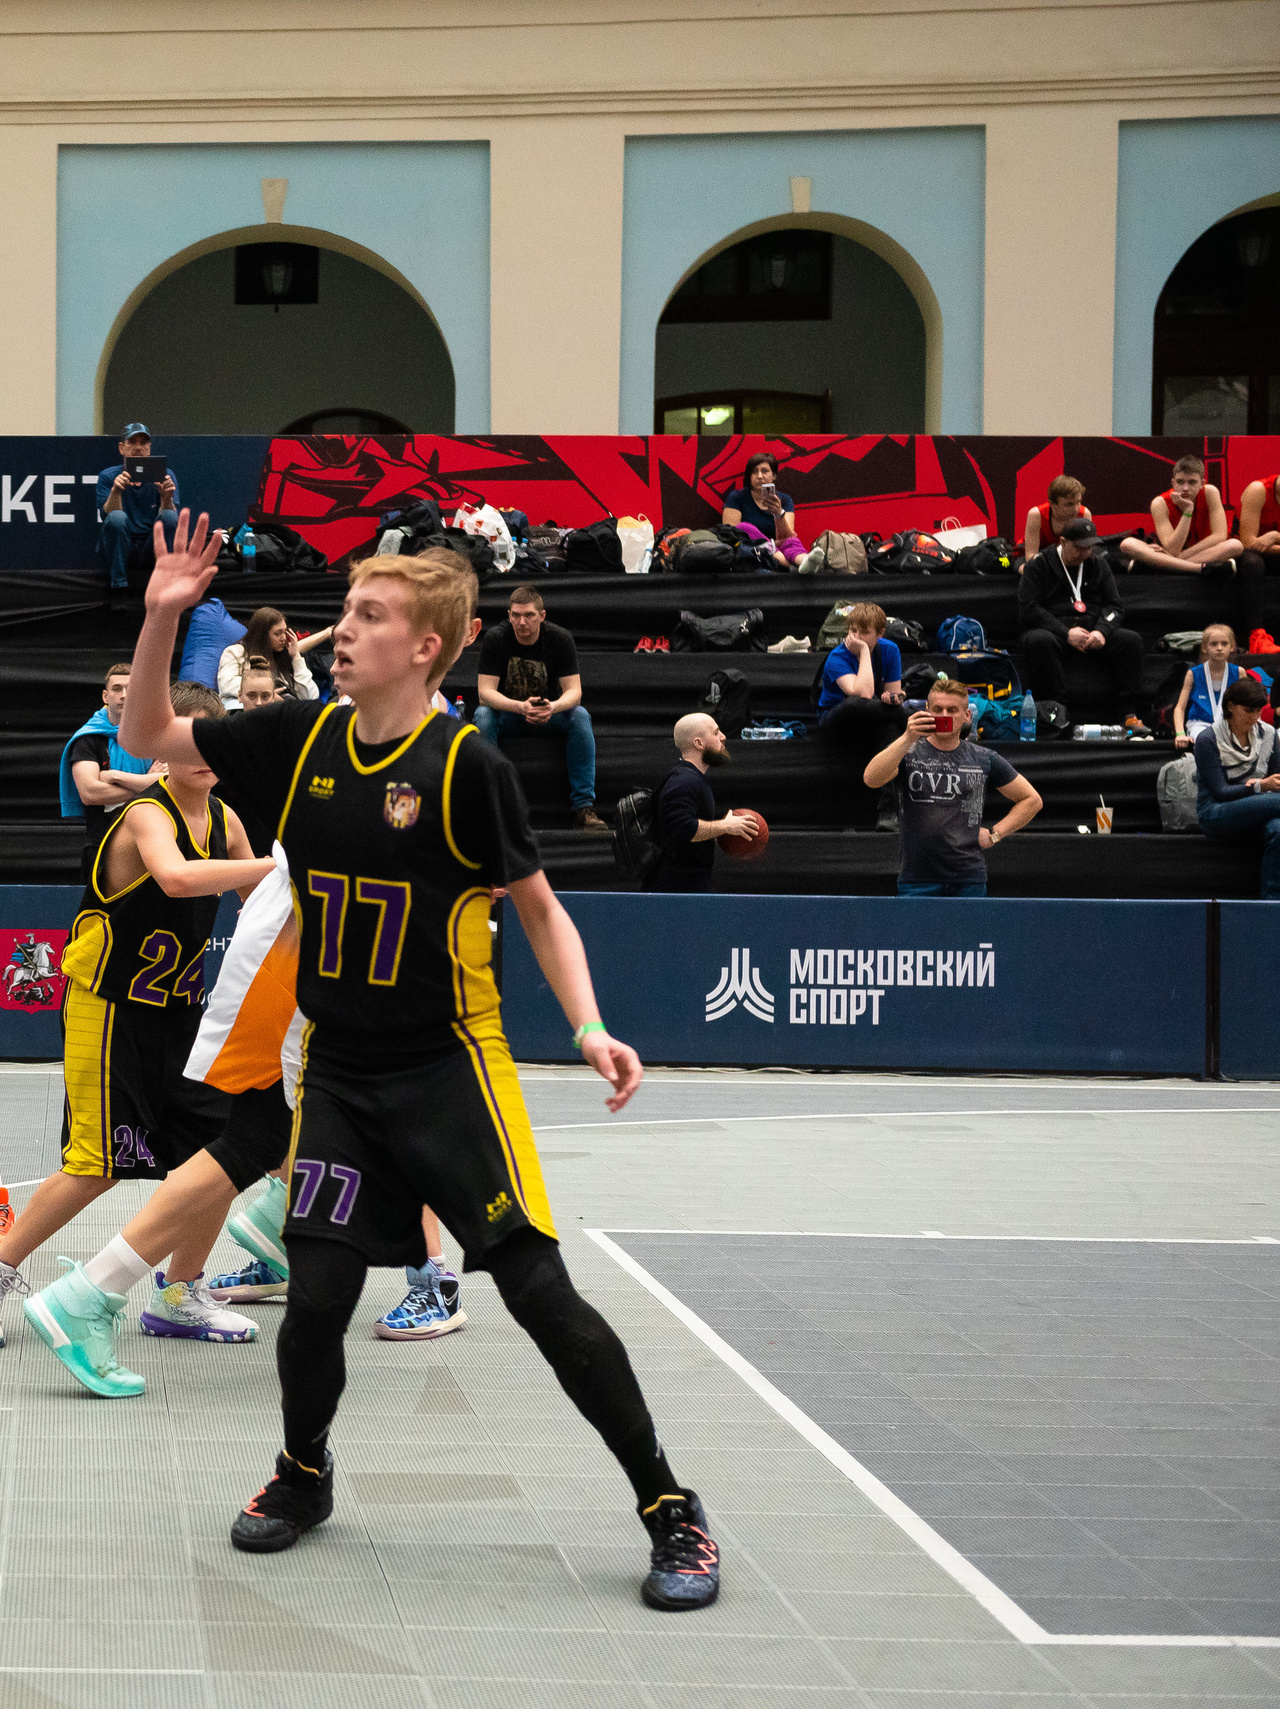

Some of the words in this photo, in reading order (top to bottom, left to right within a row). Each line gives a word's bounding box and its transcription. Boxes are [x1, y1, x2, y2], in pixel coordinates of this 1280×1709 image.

[908, 770, 962, 795] CVR
[308, 868, 412, 986] 77
[128, 928, 210, 1007] 24
[790, 943, 995, 987] МОСКОВСКИЙ
[790, 988, 885, 1025] СПОРТ
[114, 1124, 156, 1167] 24
[292, 1159, 362, 1226] 77
